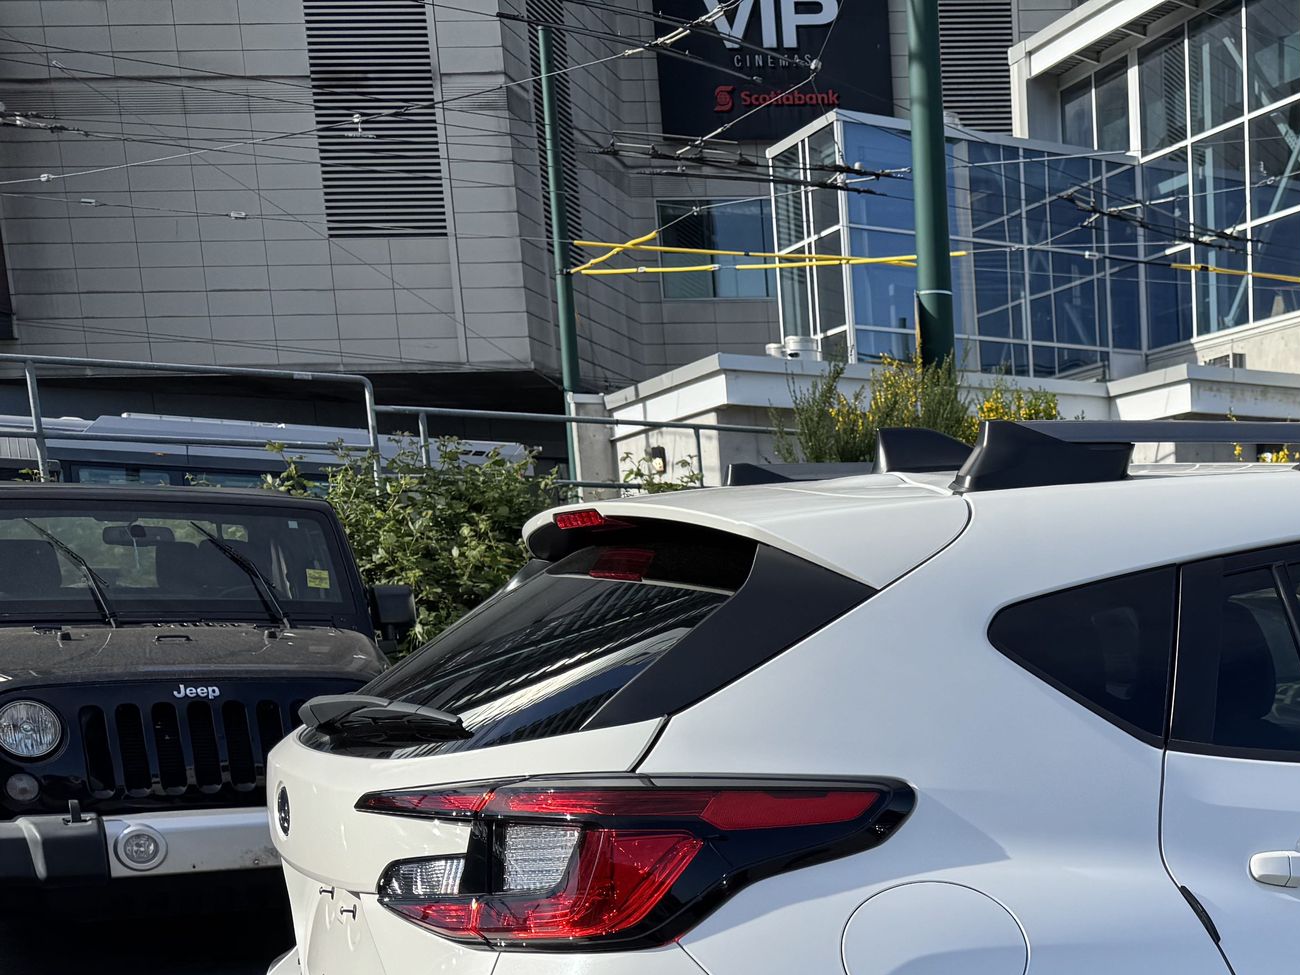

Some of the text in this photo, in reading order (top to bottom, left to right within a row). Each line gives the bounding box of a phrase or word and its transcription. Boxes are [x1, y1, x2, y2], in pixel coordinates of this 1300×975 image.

[703, 0, 839, 48] VIP
[734, 54, 812, 67] CINEMAS
[741, 88, 839, 105] Scotiabank
[173, 684, 220, 699] Jeep
